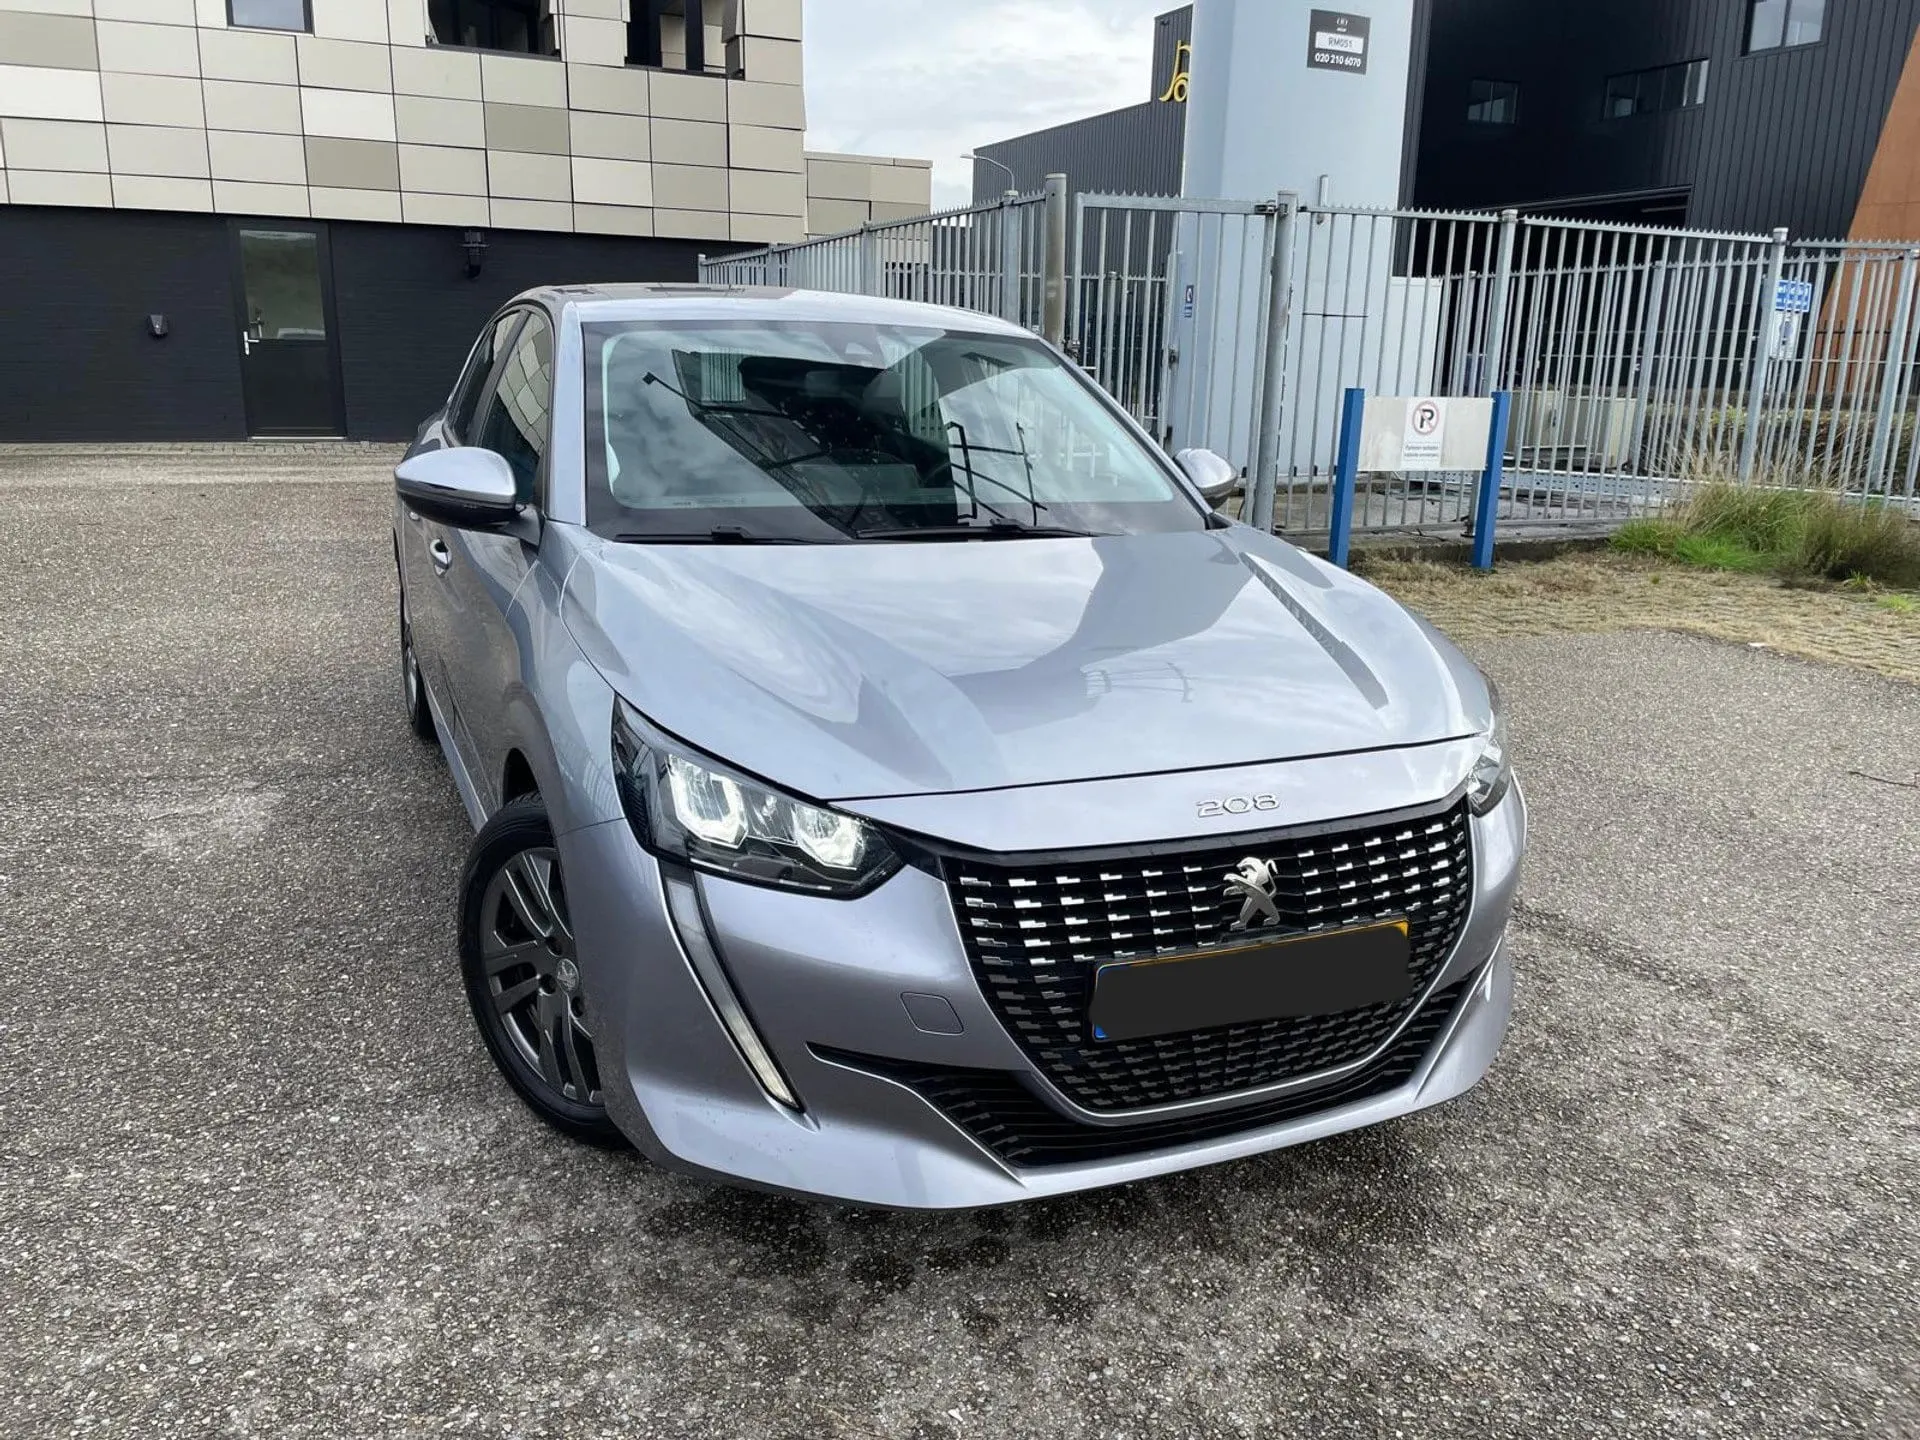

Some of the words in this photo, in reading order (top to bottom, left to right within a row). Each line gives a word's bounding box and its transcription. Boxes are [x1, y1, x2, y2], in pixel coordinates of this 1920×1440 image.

[1315, 52, 1330, 63] 020
[1330, 54, 1344, 65] 210
[1344, 56, 1361, 67] 6070
[1196, 794, 1280, 818] 208
